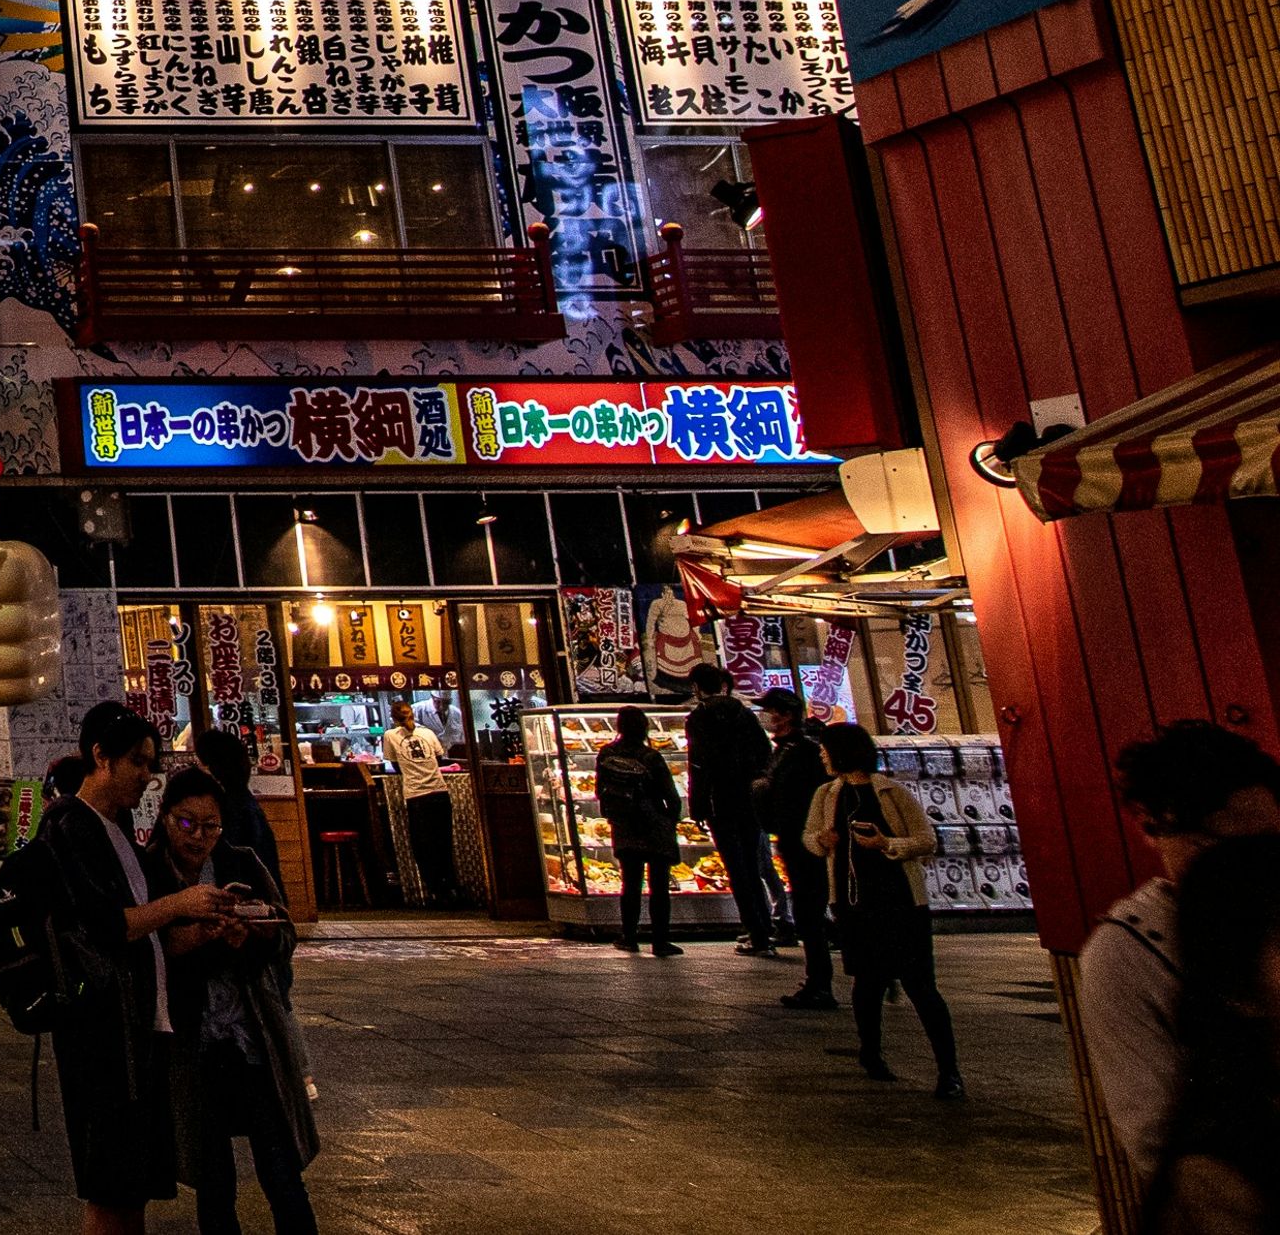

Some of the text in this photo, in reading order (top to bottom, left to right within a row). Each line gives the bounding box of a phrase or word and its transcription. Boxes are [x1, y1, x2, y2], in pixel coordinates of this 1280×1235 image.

[84, 34, 112, 115] もち
[111, 34, 140, 115] うずら玉子
[136, 34, 168, 115] 紅しょうが
[162, 34, 192, 115] にんにく
[190, 34, 220, 115] 玉ねぎ
[216, 34, 246, 115] 山芋
[270, 34, 301, 115] れんこん
[295, 34, 327, 115] 銀杏
[324, 34, 354, 115] 白ねぎ
[350, 34, 380, 115] さつま芋
[376, 34, 408, 115] じゃが芋
[402, 34, 434, 115] 茄子
[428, 34, 460, 115] 椎茸
[510, 85, 603, 119] 大阪
[638, 36, 674, 116] 海老
[666, 36, 702, 116] キス
[692, 36, 728, 116] 貝柱
[716, 36, 752, 116] サーモン
[743, 36, 777, 116] たこ
[768, 36, 805, 116] いか
[821, 36, 856, 116] ホルモン
[90, 388, 453, 460] 新世界 日本一の串かつ 横綱 酒処
[468, 386, 791, 460] 新世界 日本一の串かつ 横綱
